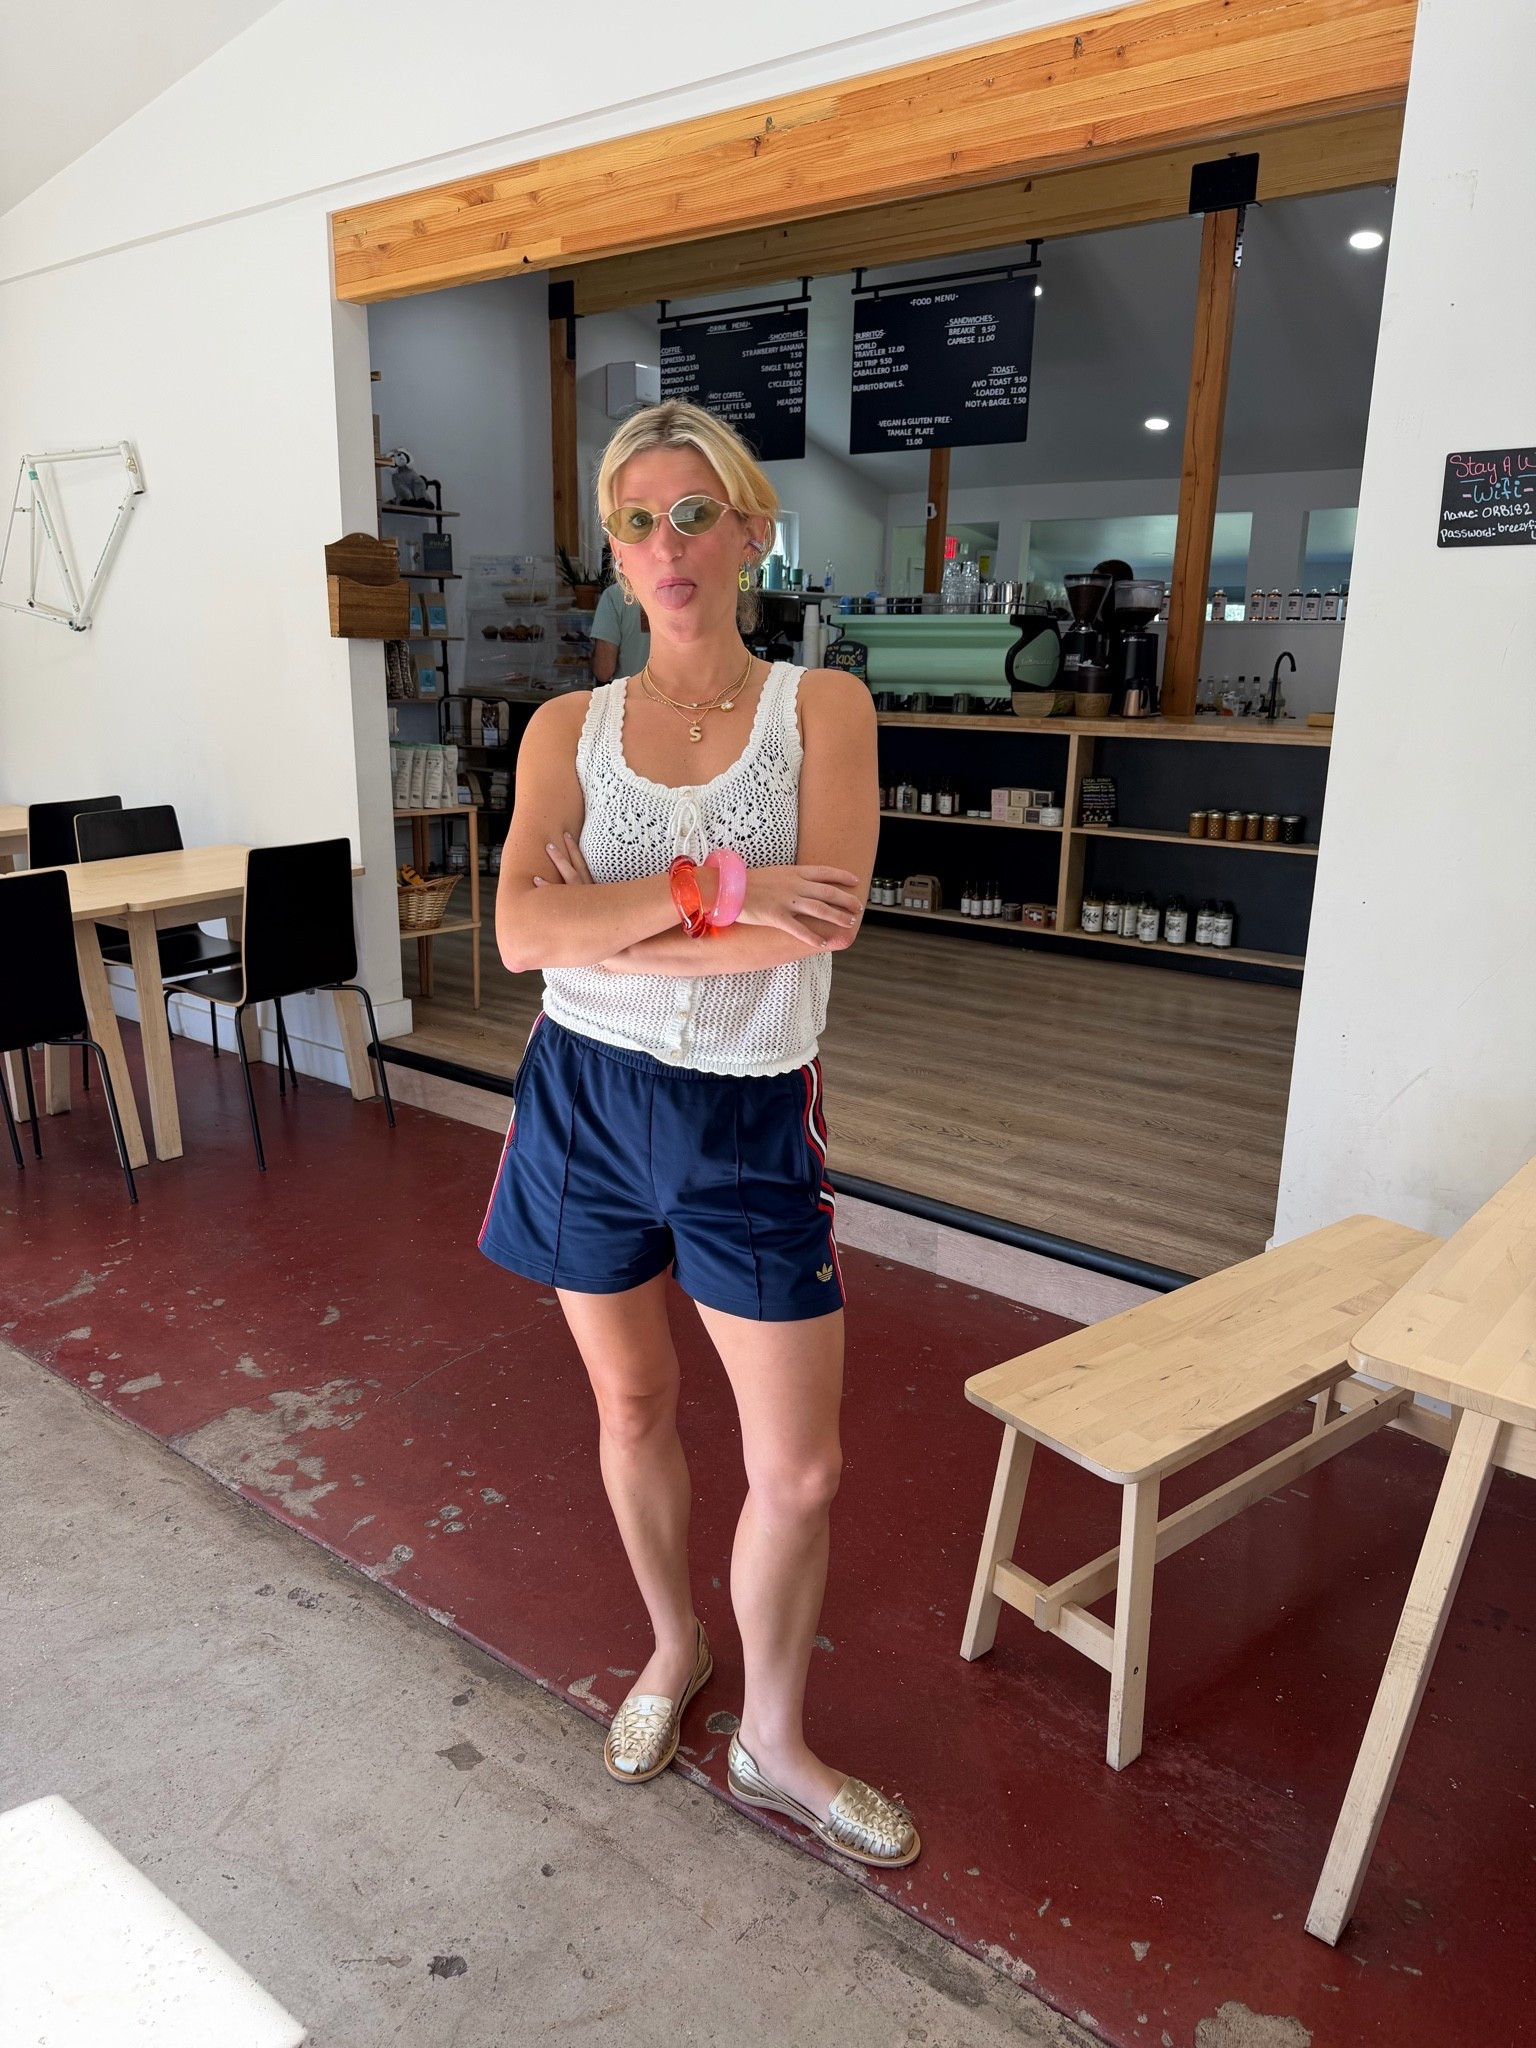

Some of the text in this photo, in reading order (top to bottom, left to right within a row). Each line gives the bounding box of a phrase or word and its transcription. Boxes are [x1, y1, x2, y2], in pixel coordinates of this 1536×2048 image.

[947, 334, 995, 345] CAPRESE 11.00
[742, 343, 804, 358] STRAWBERRY BANANA
[854, 342, 877, 350] WORLD
[854, 349, 886, 358] TRAVELER
[661, 365, 690, 375] AMERICANO
[761, 364, 781, 372] SINGLE
[853, 364, 908, 377] CABALLERO 11.00
[971, 380, 987, 388] AVO
[989, 377, 1012, 386] TOAST
[776, 397, 803, 406] MEADOW
[907, 417, 933, 425] GLUTEN
[1450, 454, 1497, 484] Stay
[1503, 456, 1512, 476] A
[1482, 503, 1532, 518] ORB182
[1440, 527, 1496, 542] password:
[836, 654, 856, 666] KIDS
[689, 726, 702, 743] S
